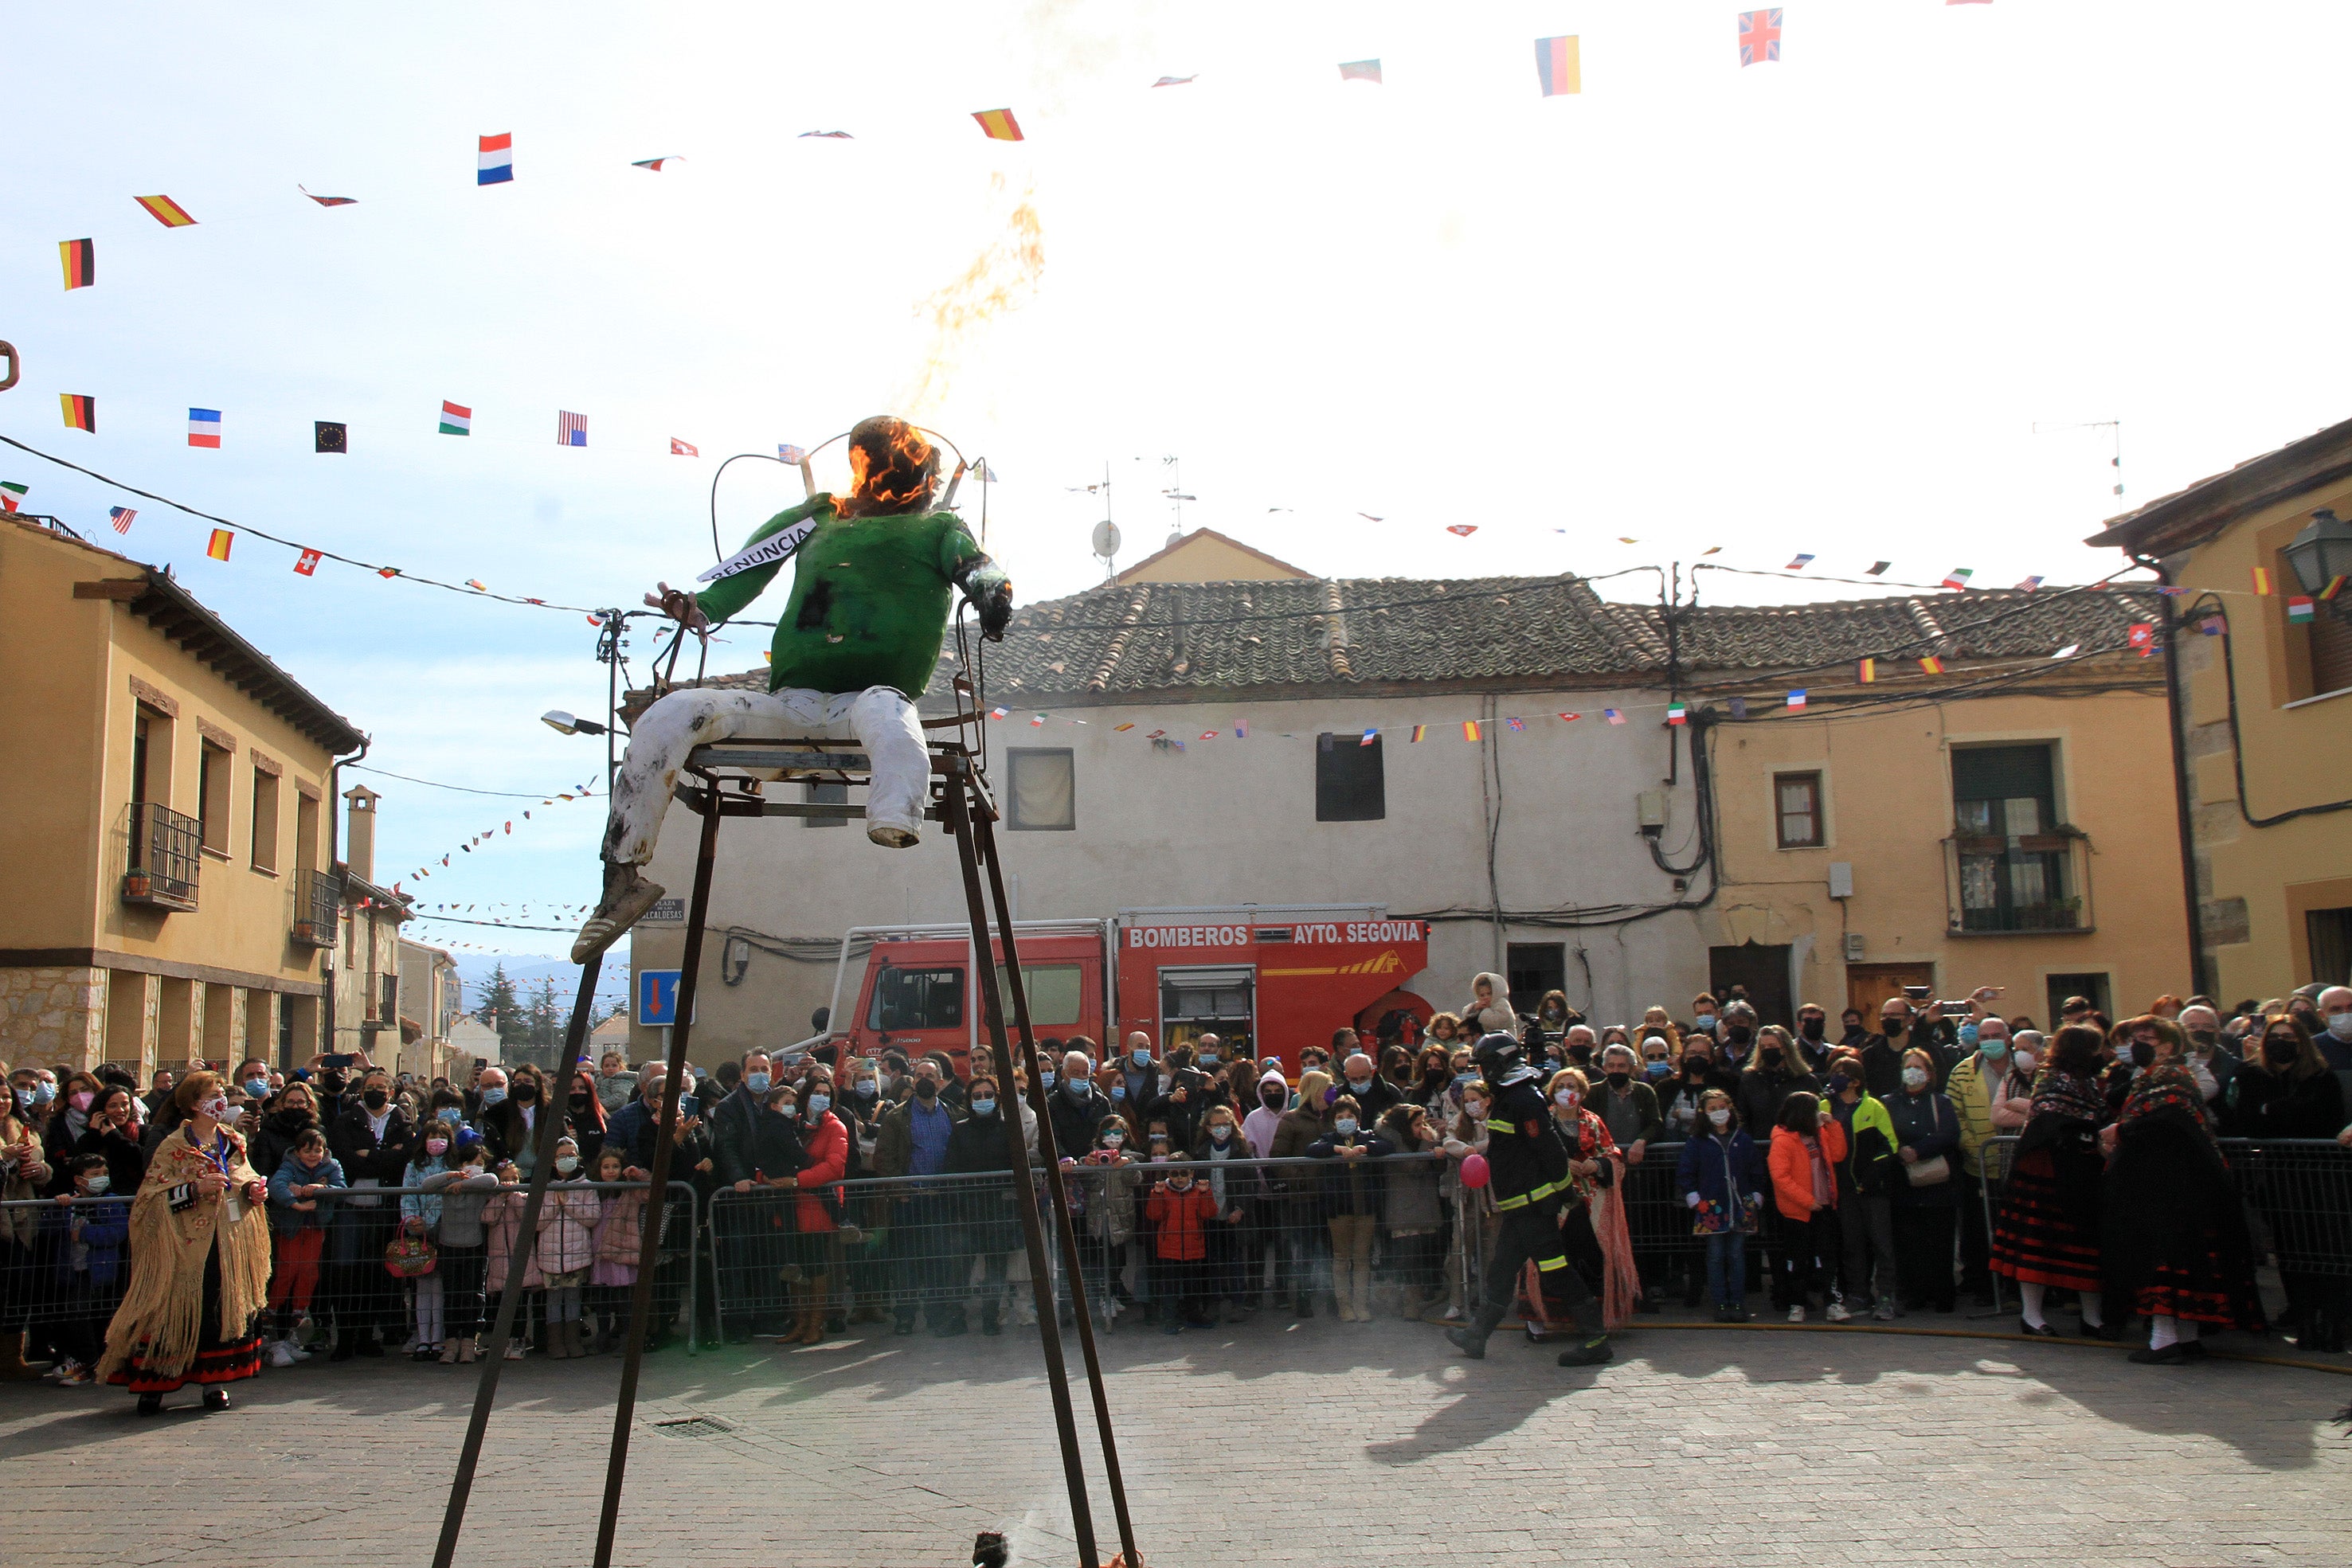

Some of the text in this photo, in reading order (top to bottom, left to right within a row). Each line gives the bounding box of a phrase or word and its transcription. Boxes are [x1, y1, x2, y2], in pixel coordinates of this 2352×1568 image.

[1129, 926, 1248, 948] BOMBEROS
[1293, 922, 1420, 944] AYTO. SEGOVIA
